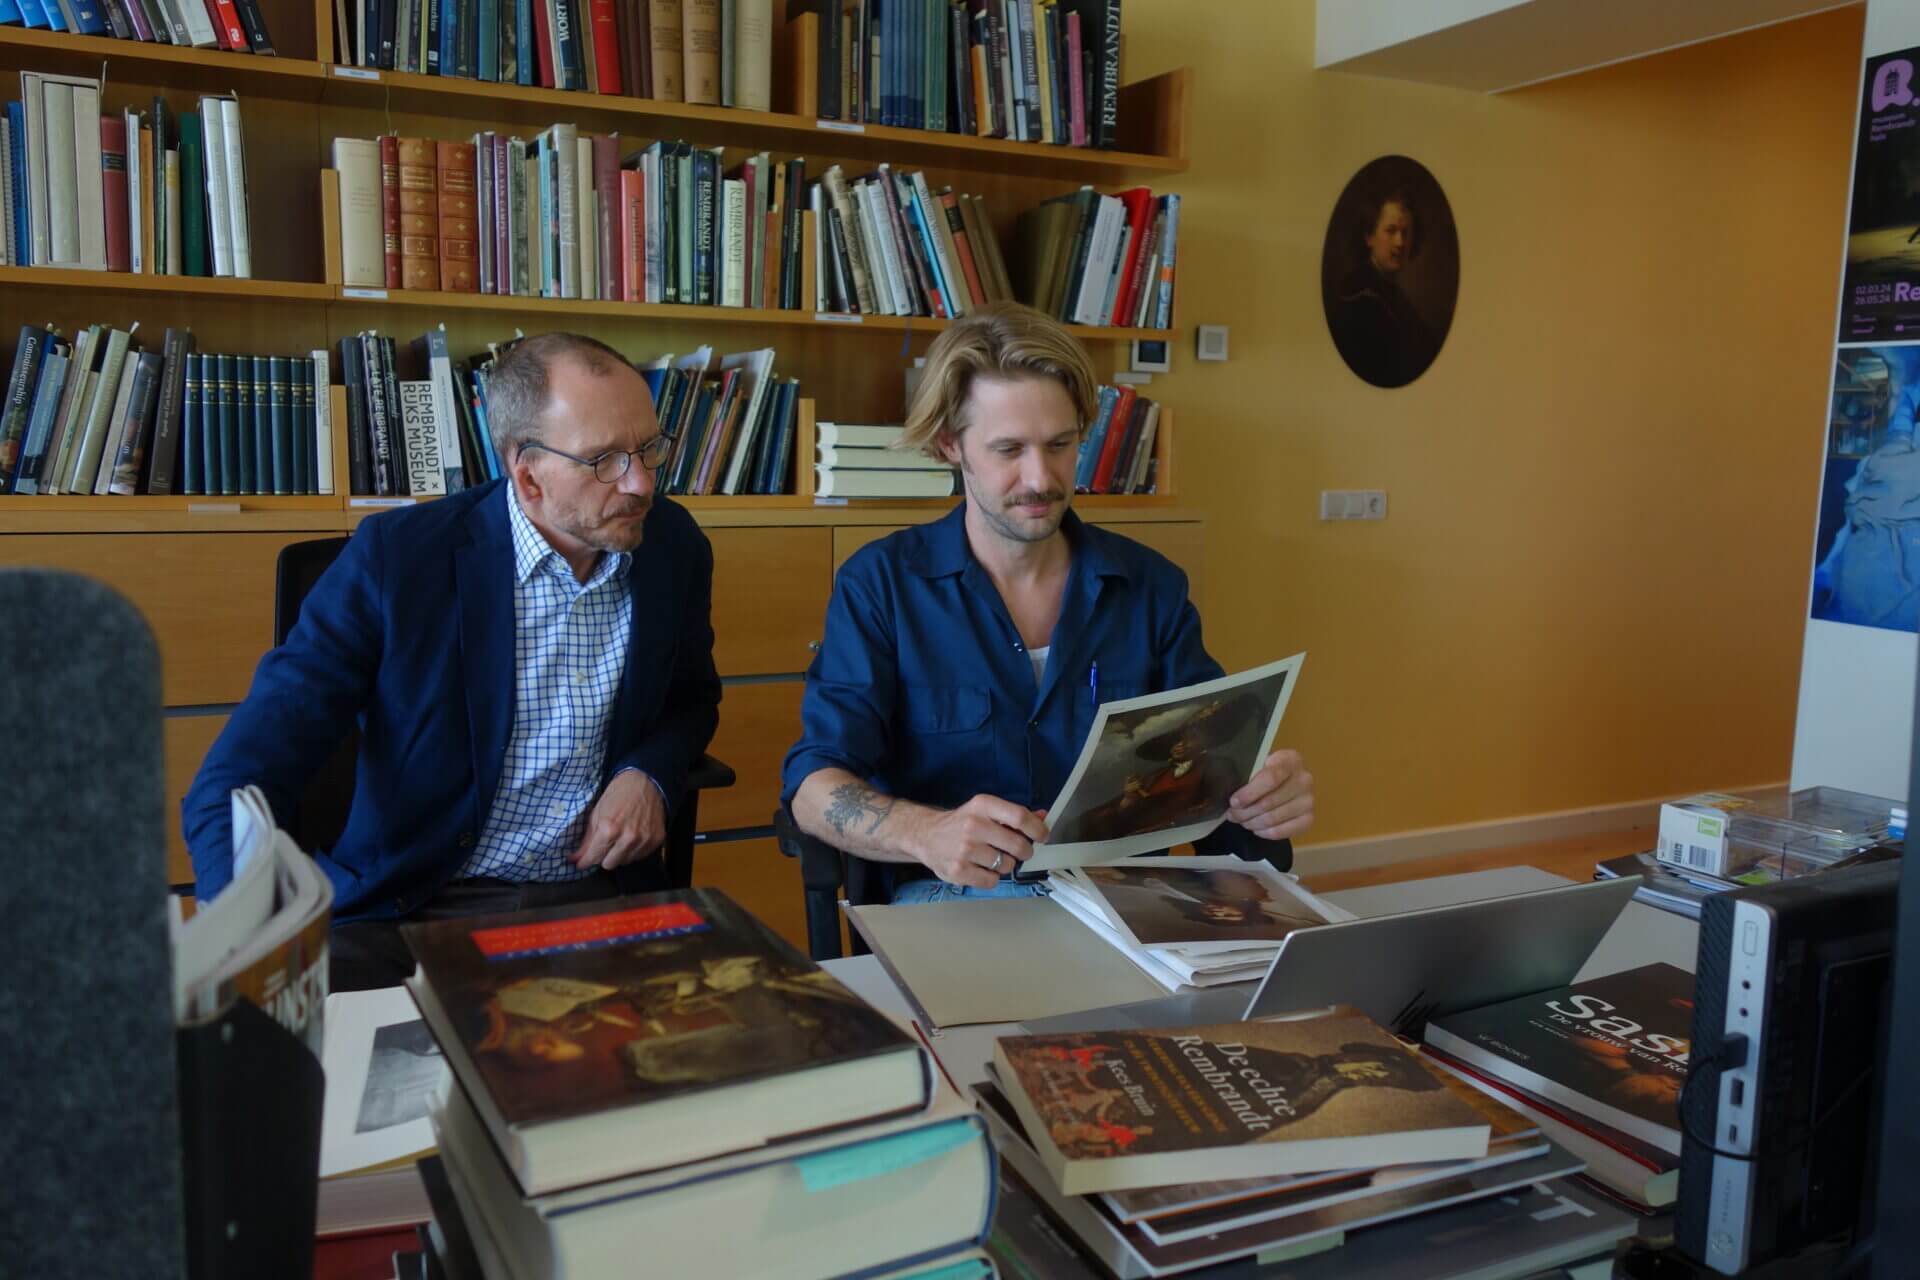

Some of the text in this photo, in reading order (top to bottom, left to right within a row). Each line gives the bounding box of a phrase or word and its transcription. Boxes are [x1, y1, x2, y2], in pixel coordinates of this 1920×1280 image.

[1103, 0, 1121, 126] REMBRANDT
[702, 180, 712, 251] REMBRANDT
[728, 187, 743, 263] REMBRANDT
[370, 371, 390, 460] LATE REMBRANDT
[418, 383, 440, 476] REMBRANDT
[408, 427, 426, 493] MUSEUM
[1548, 1012, 1572, 1026] De
[1574, 1024, 1629, 1049] vrouw
[1628, 1047, 1662, 1065] van
[1104, 1058, 1156, 1118] Kees Bruin
[1172, 1034, 1271, 1132] Rembrandt
[1212, 1041, 1297, 1118] De echte
